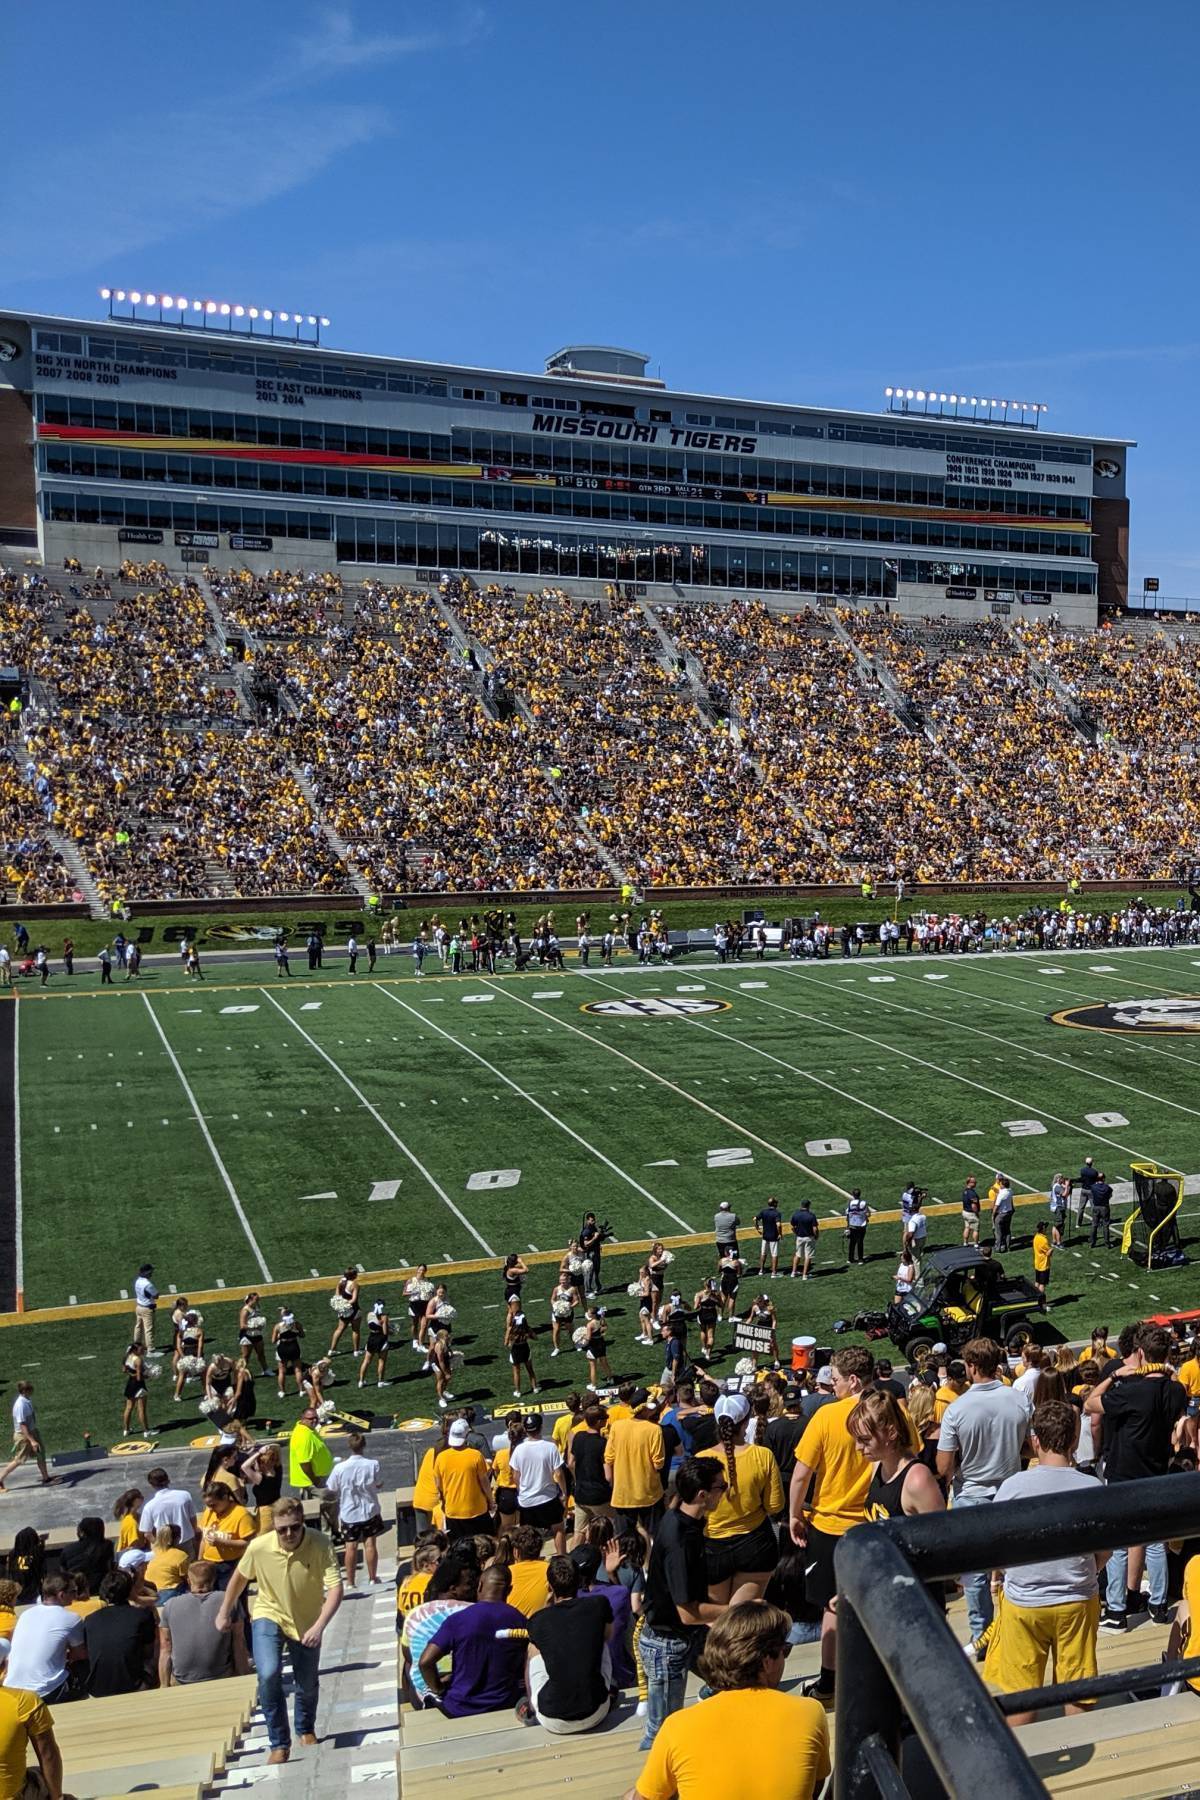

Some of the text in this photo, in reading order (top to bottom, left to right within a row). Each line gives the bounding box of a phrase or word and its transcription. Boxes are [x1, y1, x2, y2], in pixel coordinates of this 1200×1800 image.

[35, 354, 178, 380] BIG XII NORTH CHAMPIONS
[36, 366, 120, 385] 2007 2008 2010
[255, 380, 363, 400] SEC EAST CHAMPIONS
[281, 394, 305, 406] 2014
[532, 413, 758, 454] MISSOURI TIGERS
[946, 454, 1037, 472] CONFERENCE CHAMPIONS
[653, 485, 671, 494] 3RD
[736, 1323, 772, 1340] MAKE SOME
[735, 1336, 771, 1353] NOISE
